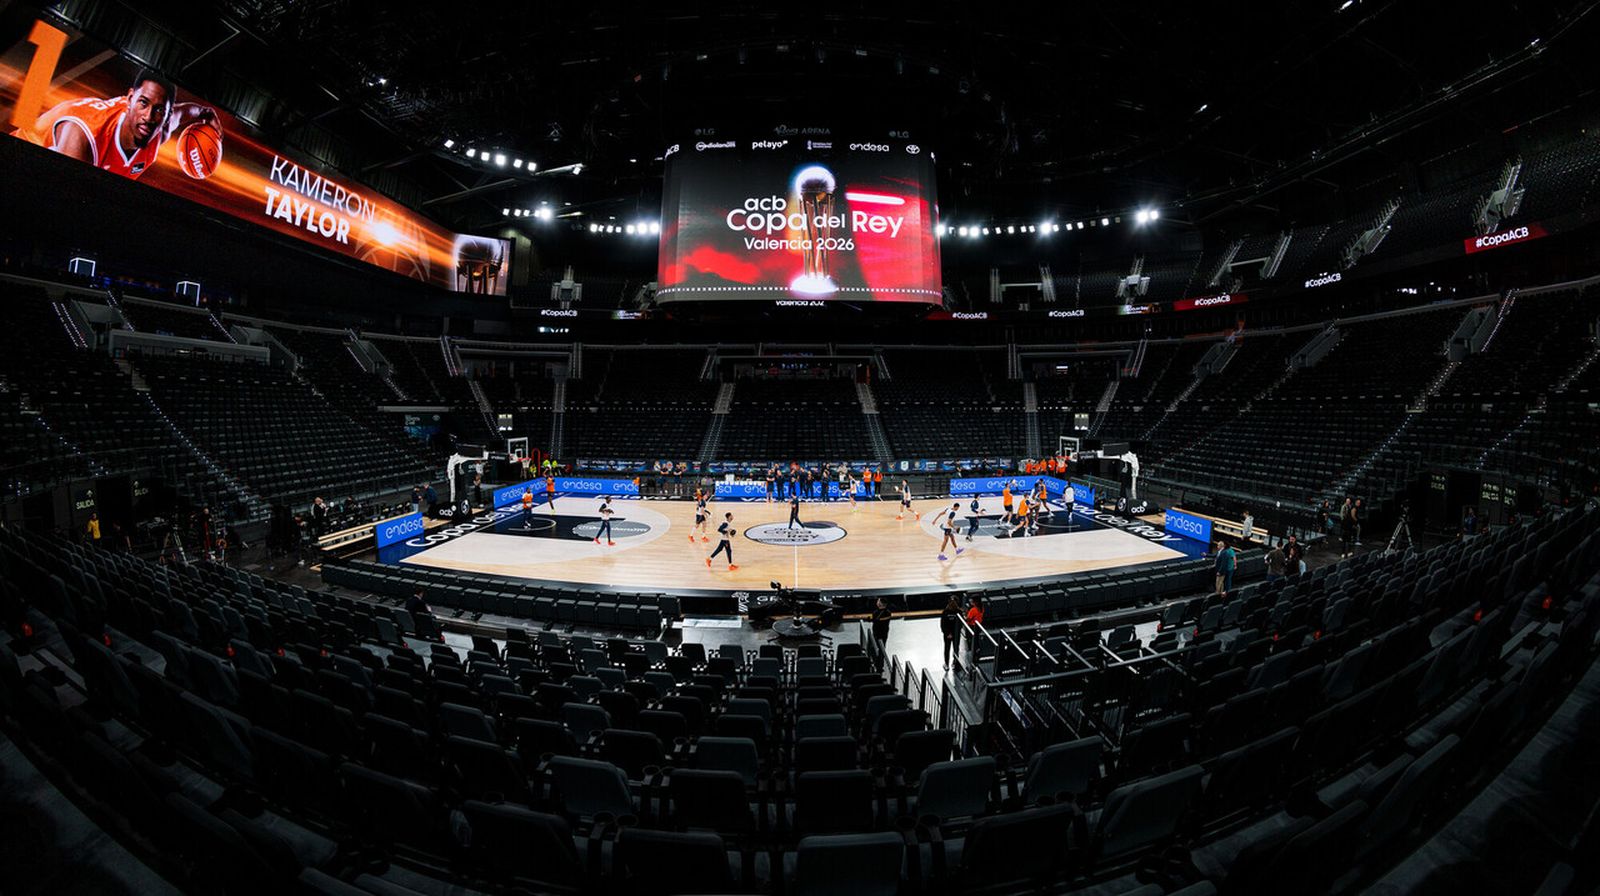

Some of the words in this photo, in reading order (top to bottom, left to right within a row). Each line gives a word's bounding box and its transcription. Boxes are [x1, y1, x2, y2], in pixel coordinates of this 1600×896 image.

[802, 127, 831, 135] ARENA
[752, 140, 782, 150] pelayo
[850, 143, 889, 152] endesa
[270, 155, 376, 225] KAMERON
[744, 195, 786, 211] acb
[265, 186, 350, 245] TAYLOR
[726, 208, 807, 234] Copa
[813, 213, 846, 228] del
[852, 210, 904, 238] Rey
[744, 237, 812, 251] Valencia
[816, 237, 855, 251] 2026
[1475, 226, 1529, 248] #CopaACB
[1304, 273, 1341, 288] #CopaACB
[1194, 294, 1231, 306] #CopaACB
[540, 309, 578, 317] #CopaACB
[1048, 309, 1085, 318] #CopaACB
[563, 480, 602, 491] endesa
[439, 508, 453, 517] acb
[1131, 504, 1146, 514] acb
[386, 517, 425, 540] endesa
[1166, 513, 1203, 535] endesa
[406, 522, 480, 547] Copa
